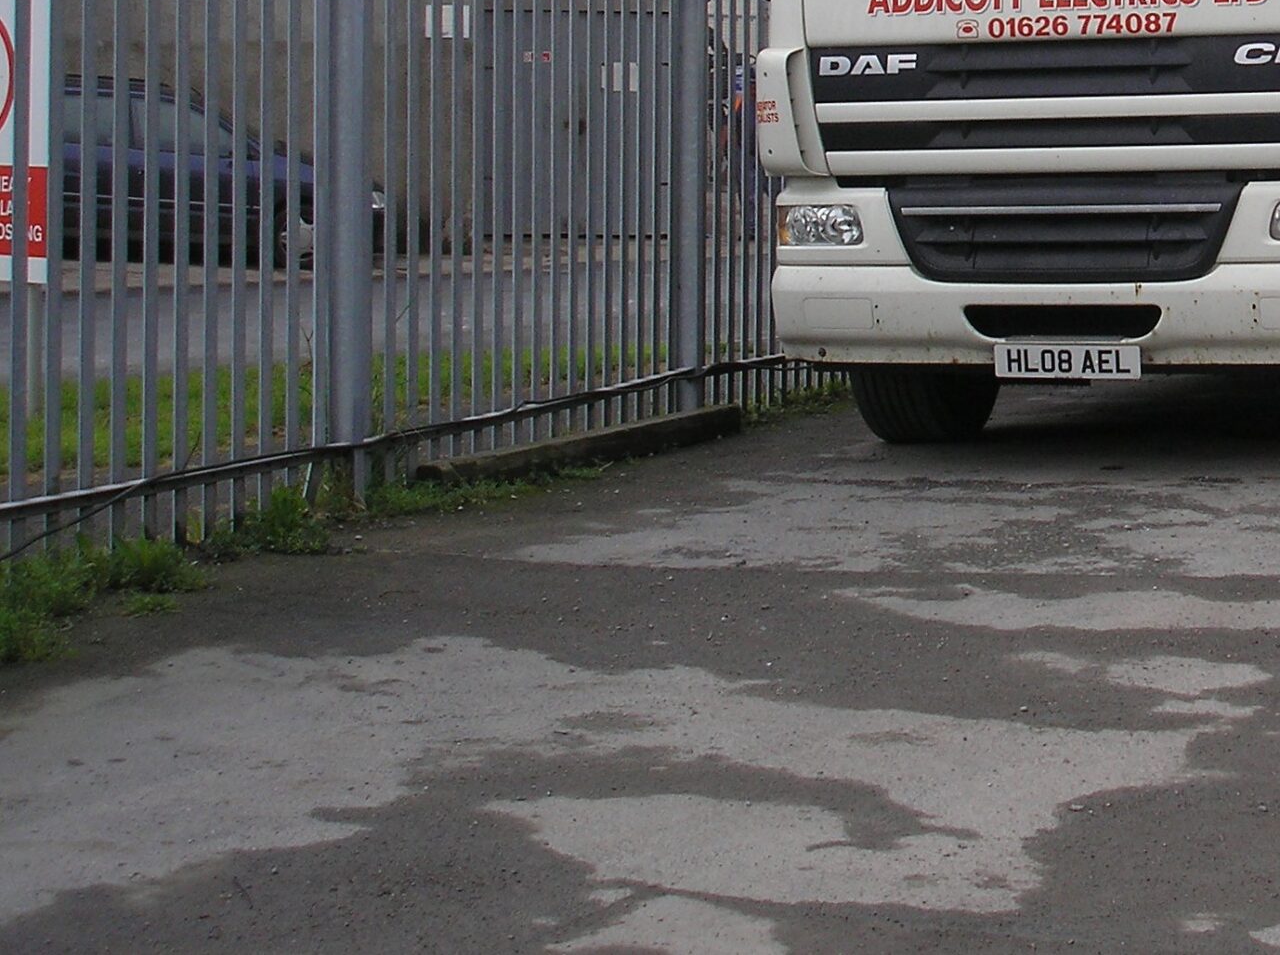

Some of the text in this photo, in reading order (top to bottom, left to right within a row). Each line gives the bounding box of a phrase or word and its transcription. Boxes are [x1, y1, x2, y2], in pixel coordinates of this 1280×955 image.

[987, 12, 1178, 39] 01626 774087
[818, 54, 918, 76] DAF
[1006, 349, 1131, 374] HL08 AEL
